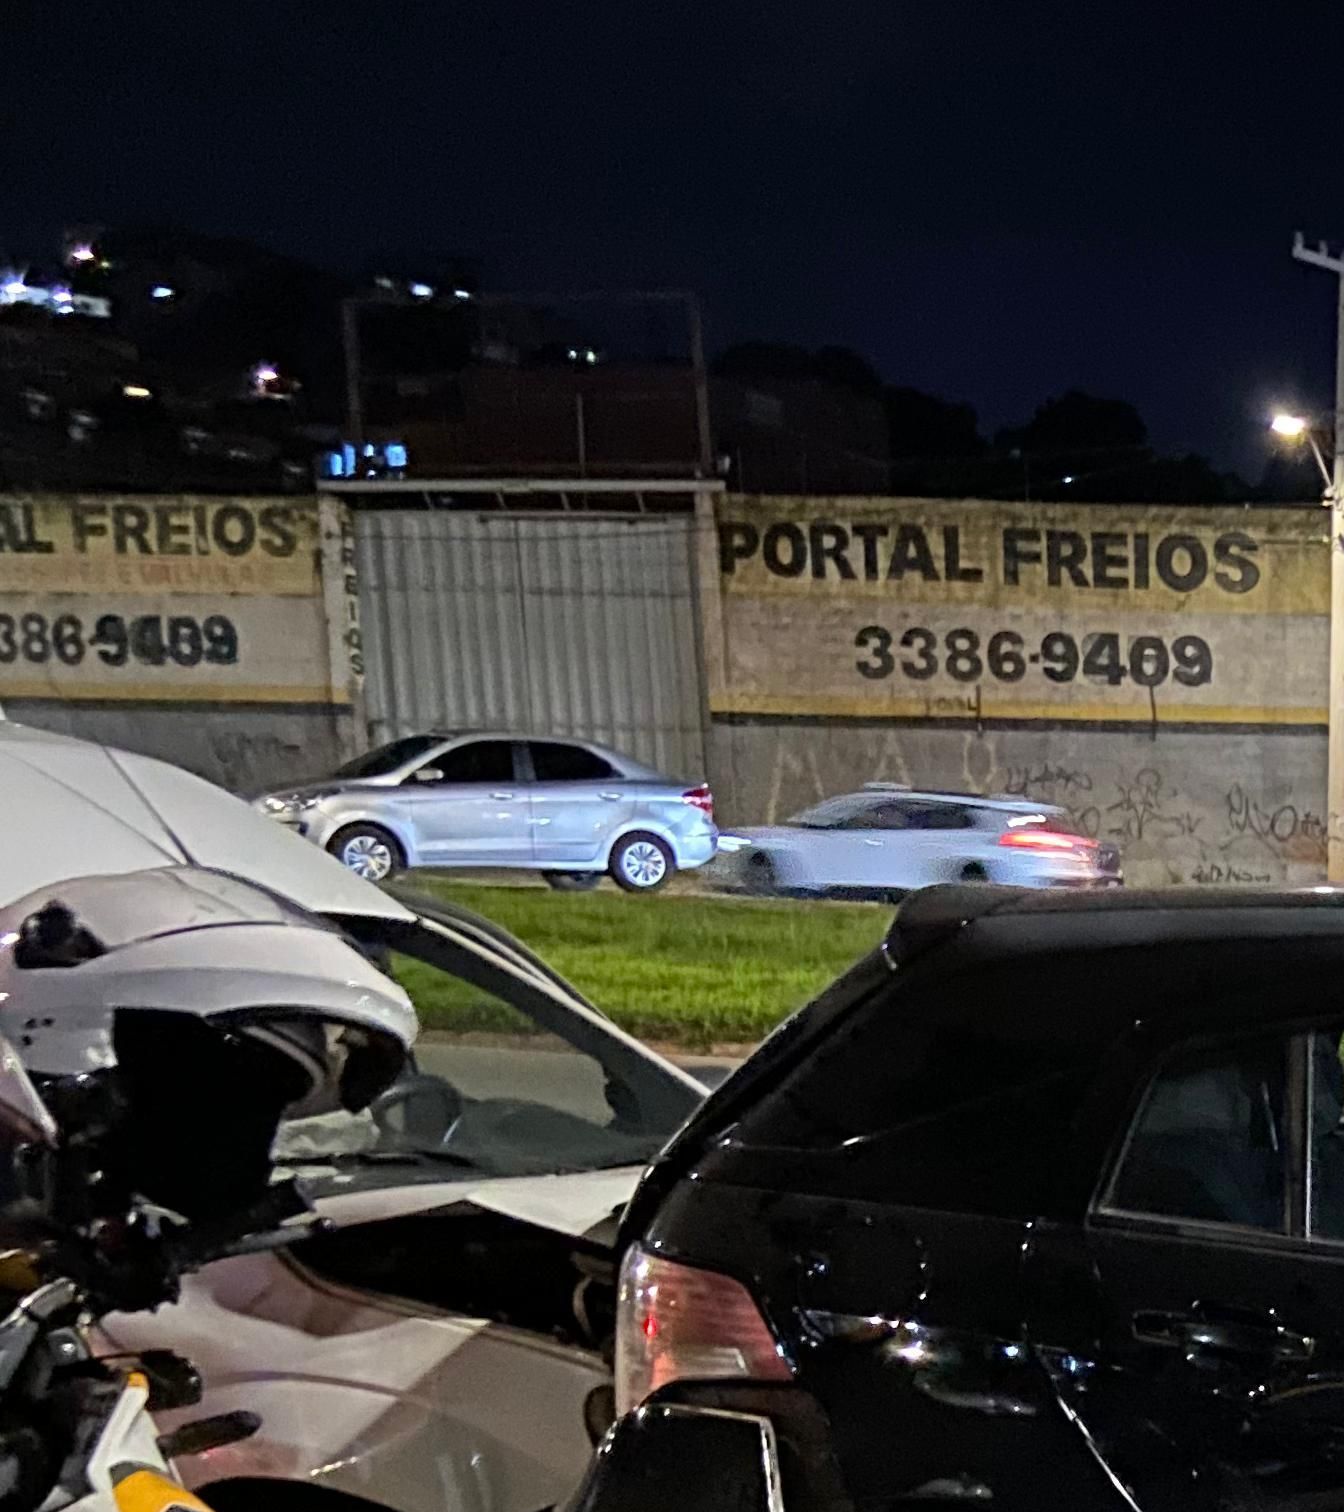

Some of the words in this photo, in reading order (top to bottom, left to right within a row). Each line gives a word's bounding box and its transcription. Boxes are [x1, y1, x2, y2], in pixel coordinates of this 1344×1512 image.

[70, 502, 299, 557] FREIOS
[717, 519, 984, 583] PORTAL
[1002, 528, 1261, 594] FREIOS
[854, 624, 1214, 688] 3386-9409
